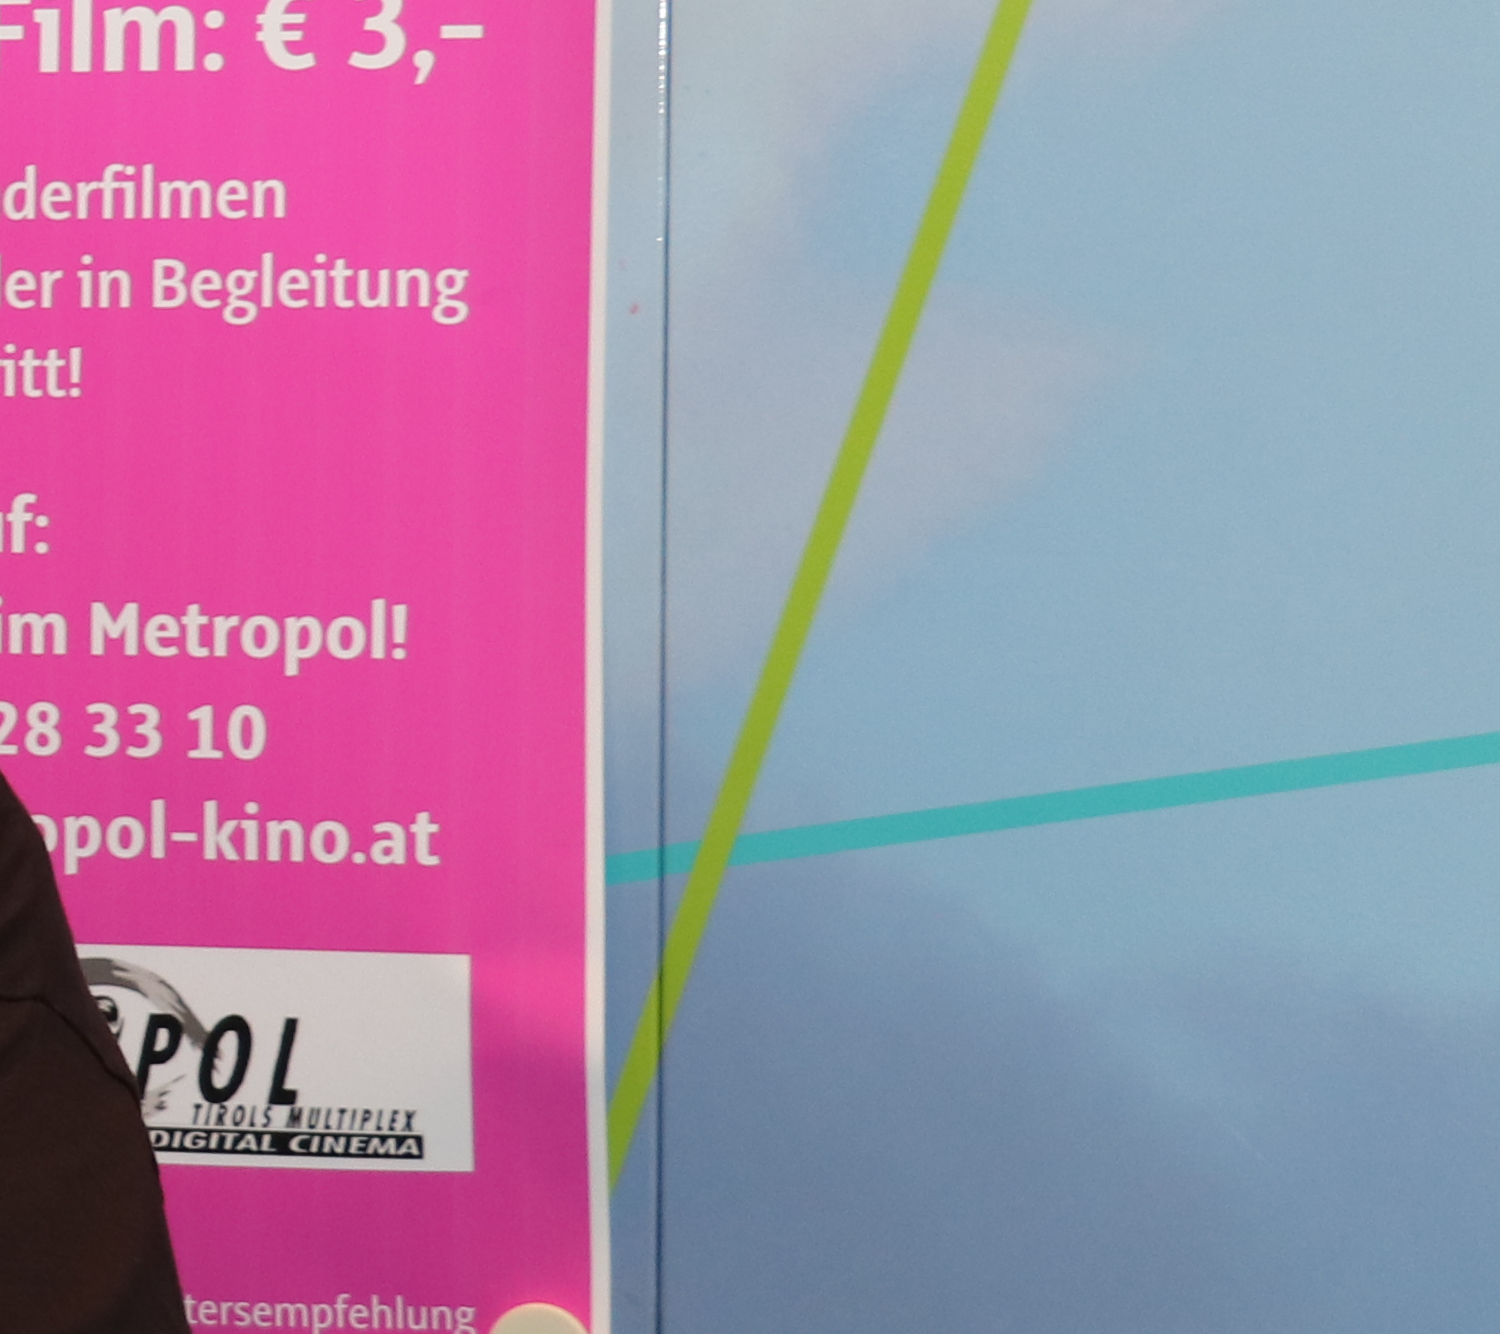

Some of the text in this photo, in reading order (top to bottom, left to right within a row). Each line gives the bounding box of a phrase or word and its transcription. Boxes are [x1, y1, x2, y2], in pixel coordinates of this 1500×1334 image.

[78, 254, 132, 310] in
[151, 252, 470, 326] Begleitung
[90, 597, 409, 676] Metropol!
[83, 703, 163, 759] 33
[187, 703, 267, 761] 10
[150, 1129, 421, 1157] DIGITAL CINEMA
[192, 1102, 417, 1134] TIROLS MULTIPLEX
